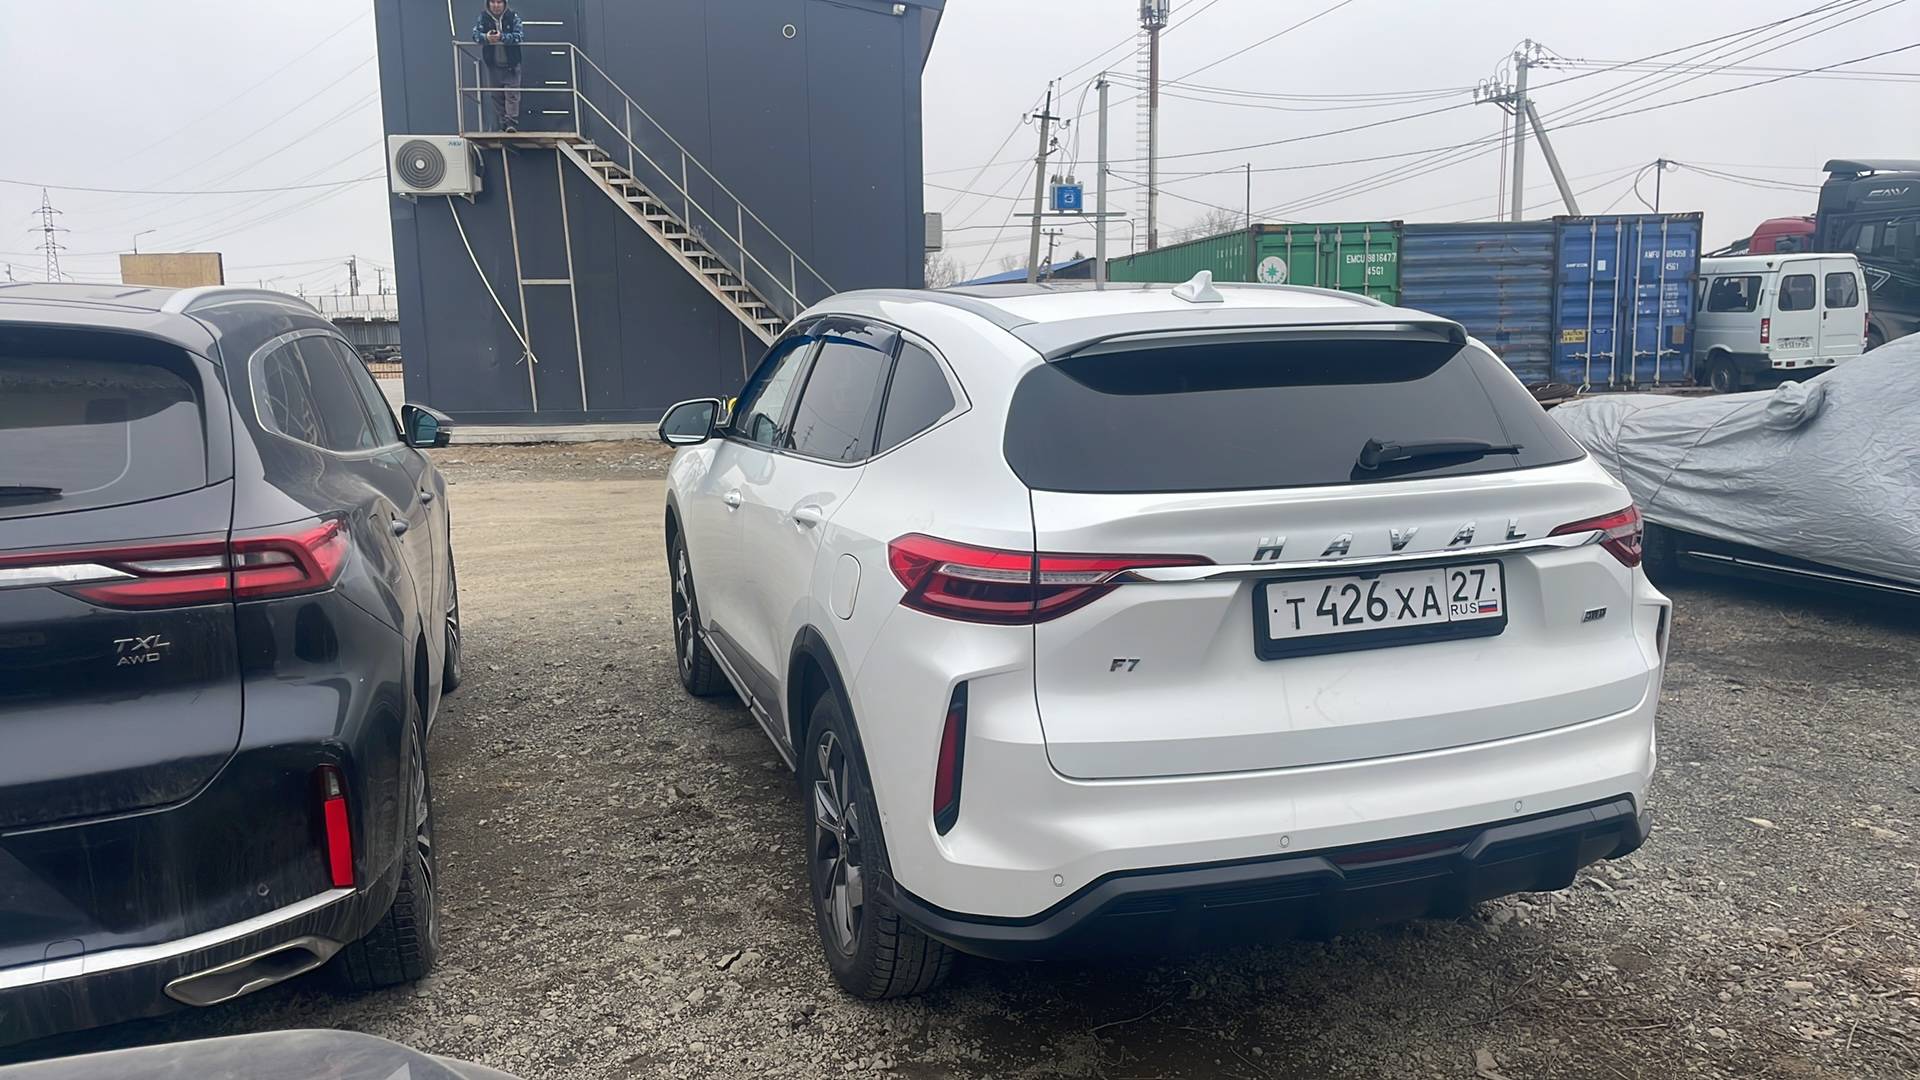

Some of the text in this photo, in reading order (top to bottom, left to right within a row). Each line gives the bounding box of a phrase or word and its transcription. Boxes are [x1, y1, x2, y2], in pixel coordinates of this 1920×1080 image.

[1346, 254, 1366, 264] EMCU
[1367, 266, 1384, 276] 45G1
[1252, 518, 1527, 561] HAVAL
[1451, 569, 1486, 602] 27
[1450, 602, 1478, 616] RUS
[113, 634, 171, 653] TXL
[116, 652, 160, 666] AWD
[1109, 658, 1141, 672] F7
